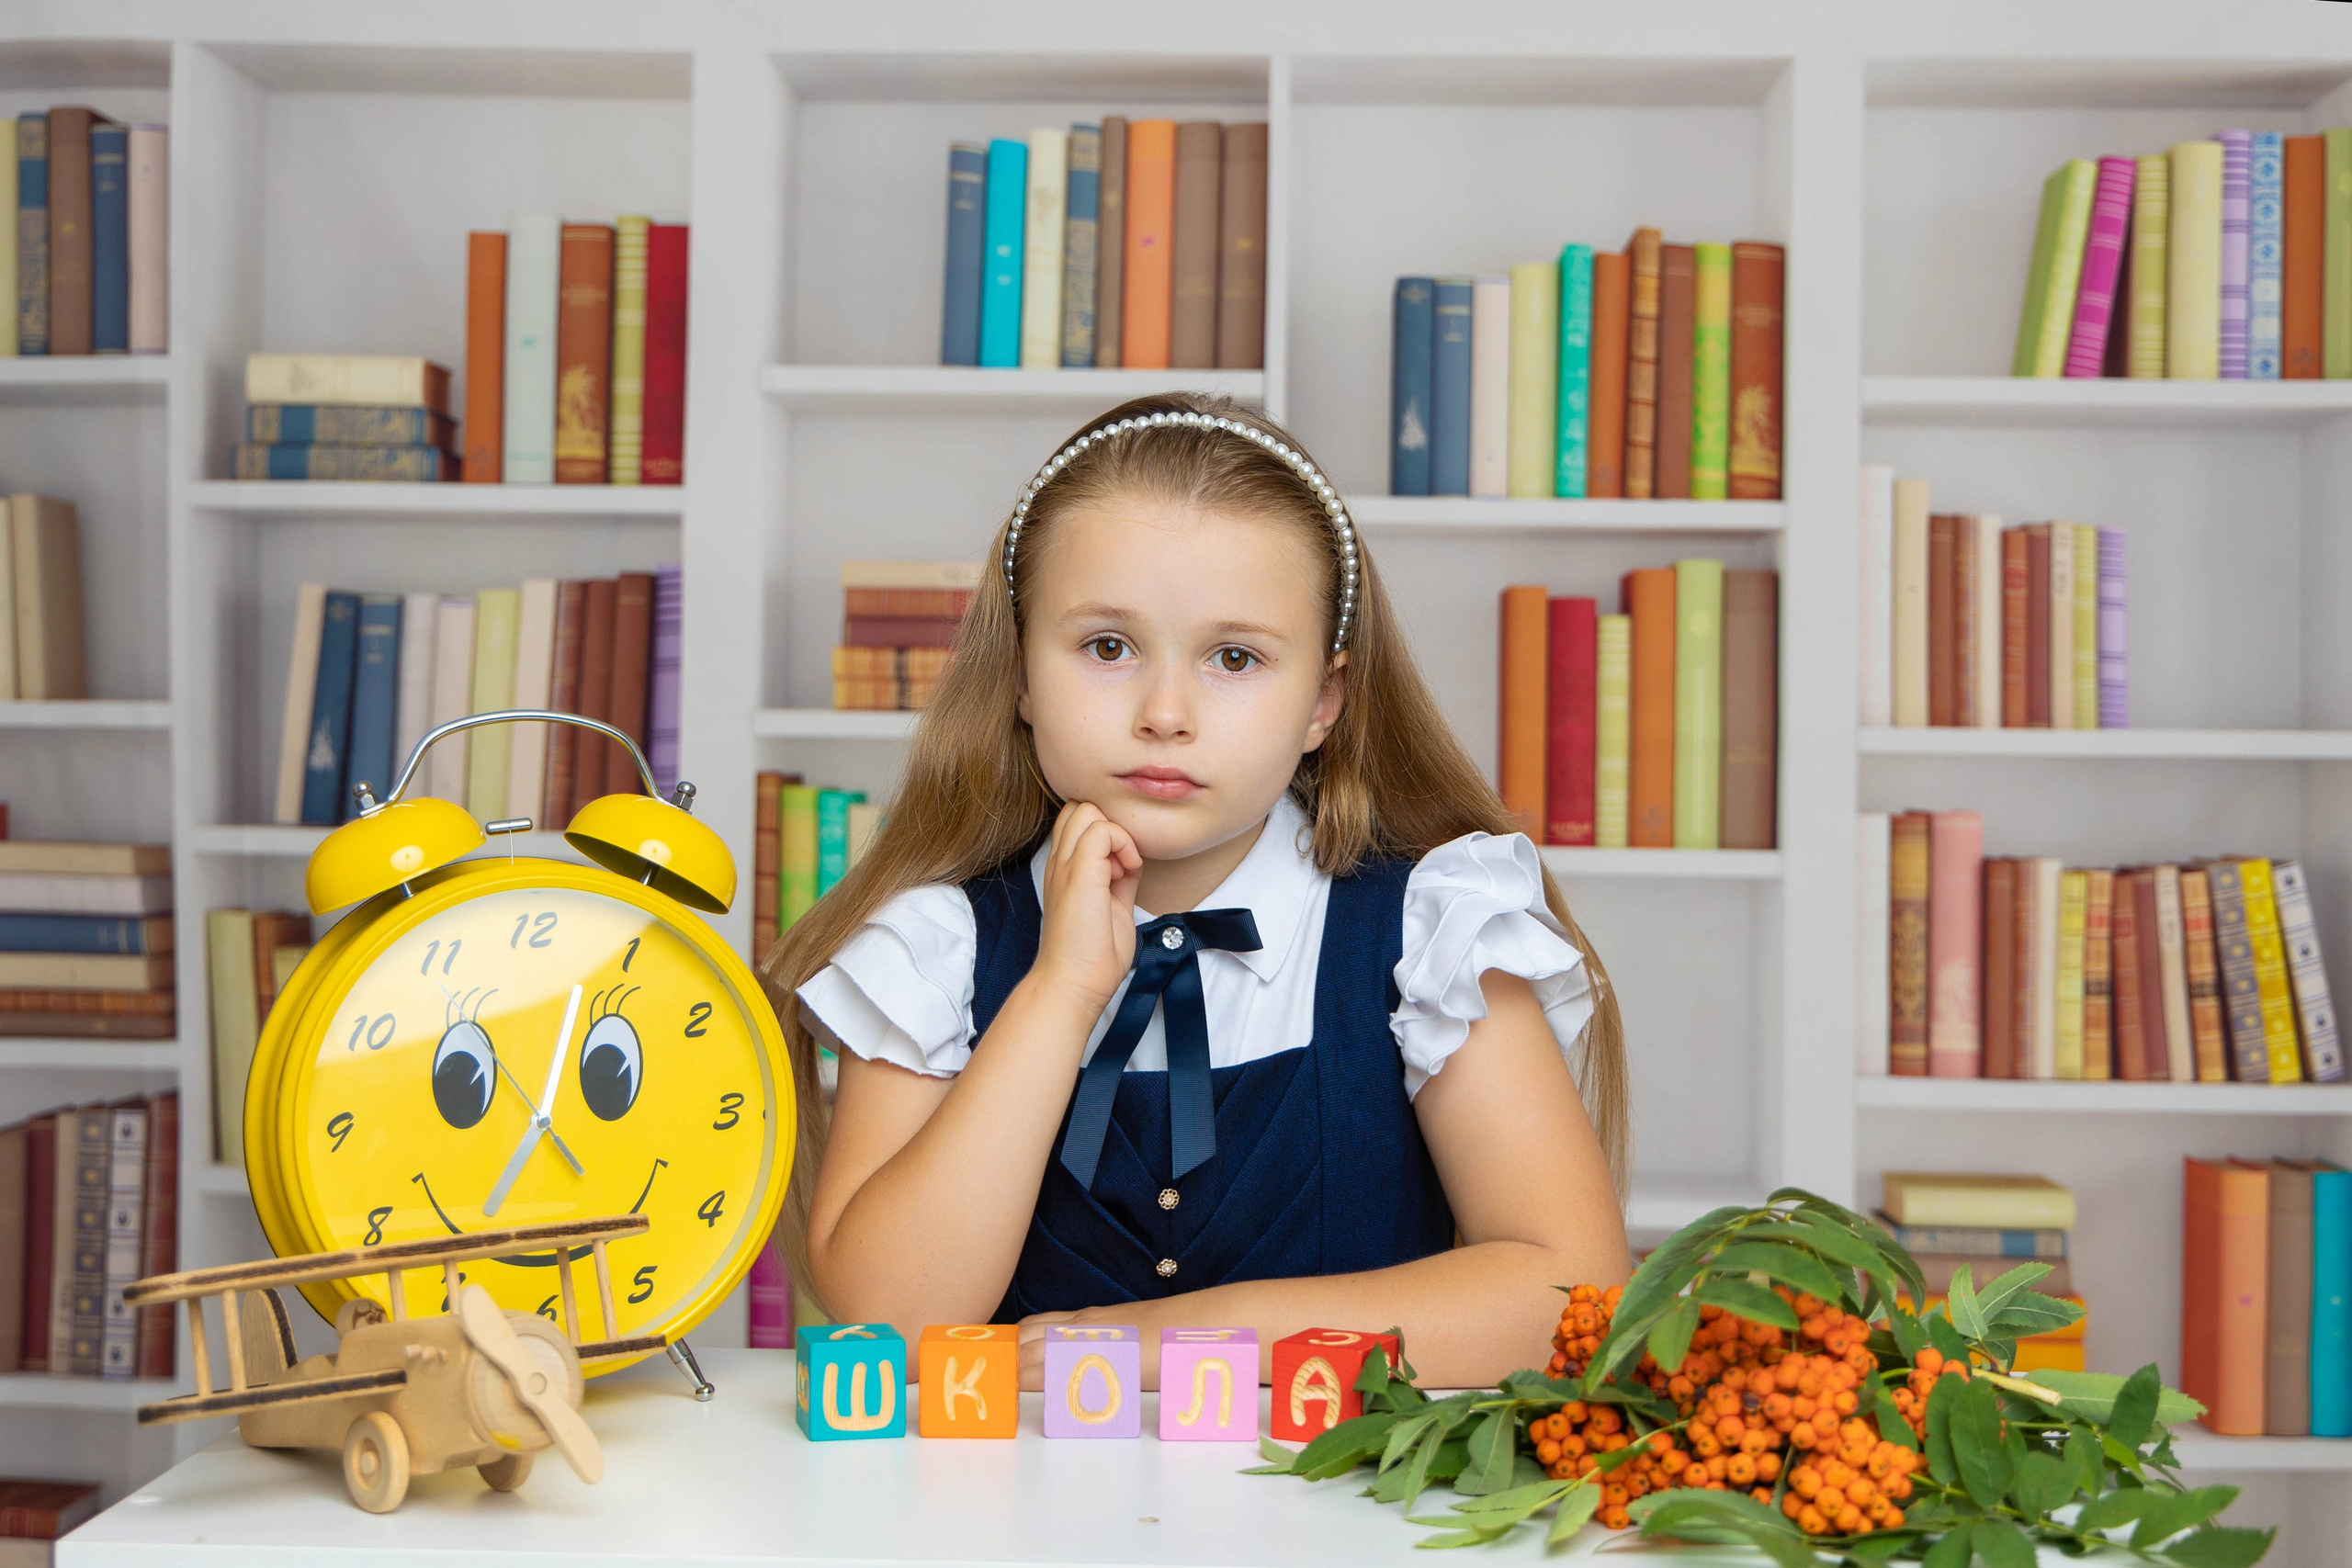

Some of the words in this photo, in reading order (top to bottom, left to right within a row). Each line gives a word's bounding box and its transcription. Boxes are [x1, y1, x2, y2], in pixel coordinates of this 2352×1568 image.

[510, 911, 558, 949] 12
[421, 939, 462, 976] 11
[623, 937, 639, 973] 1
[348, 1012, 396, 1052] 10
[684, 1001, 712, 1038] 2
[713, 1092, 745, 1130] 3
[326, 1111, 354, 1153] 9
[363, 1206, 393, 1247] 8
[697, 1190, 726, 1228] 4
[628, 1265, 658, 1304] 5
